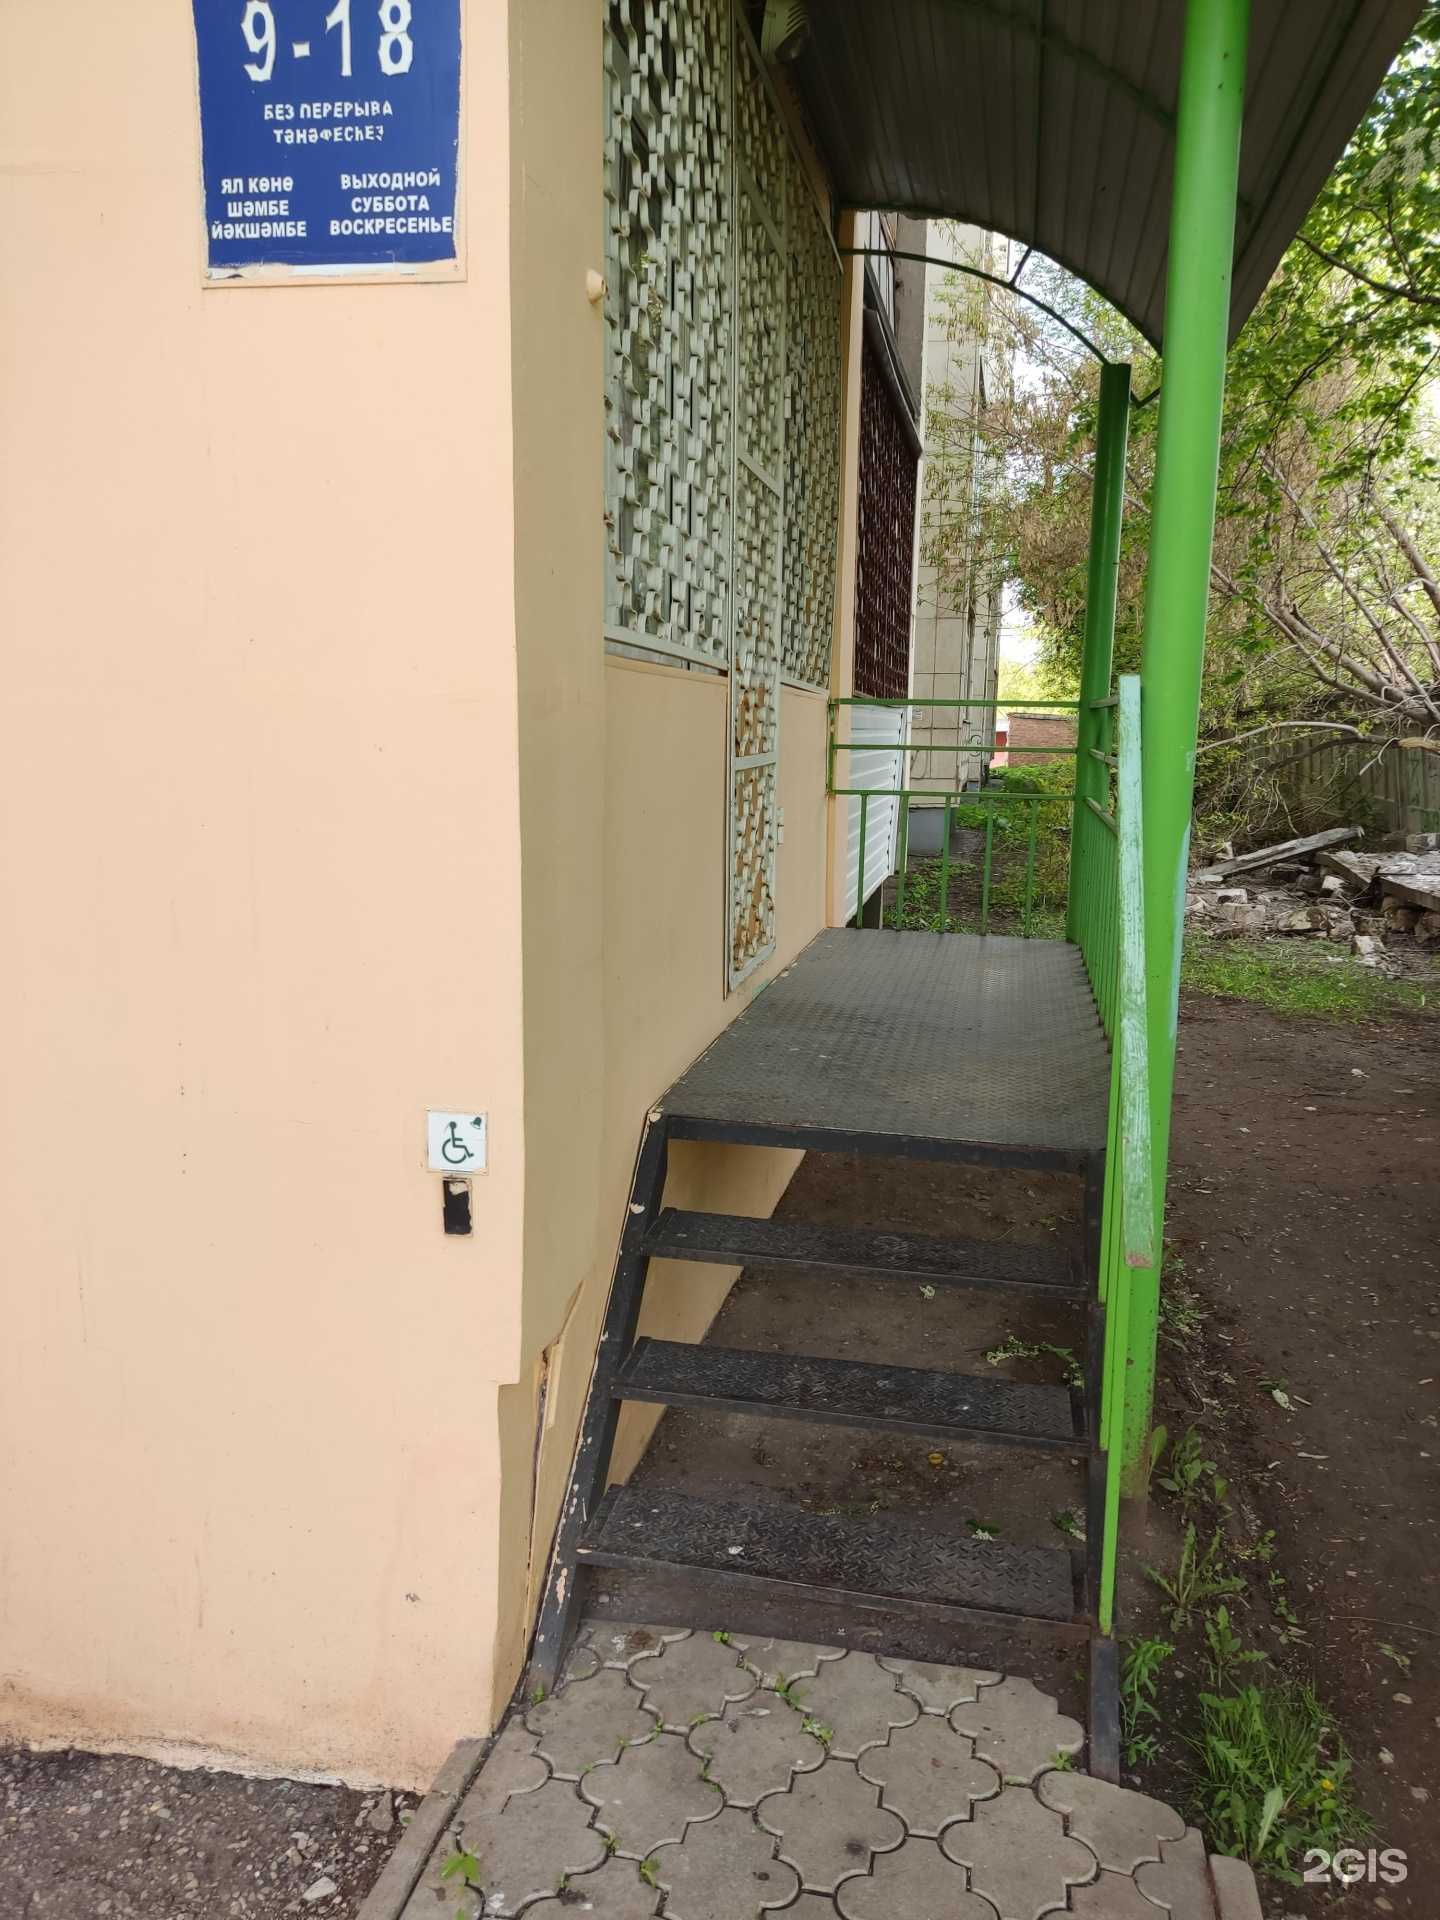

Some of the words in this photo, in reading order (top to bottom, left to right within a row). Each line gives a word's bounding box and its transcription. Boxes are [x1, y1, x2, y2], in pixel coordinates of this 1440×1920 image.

[264, 103, 295, 121] БЕЗ
[299, 100, 393, 119] ПЕРЕРЫВА
[221, 177, 244, 194] ЯЛ
[248, 176, 294, 193] КӨНӨ
[340, 167, 441, 191] ВЫХОДНОЙ
[227, 199, 290, 218] ШӘМБЕ
[351, 194, 430, 214] СУББОТА
[211, 220, 307, 240] ЙӘКШӘМБЕ
[329, 216, 453, 236] ВОСКРЕСЕНЬЕ
